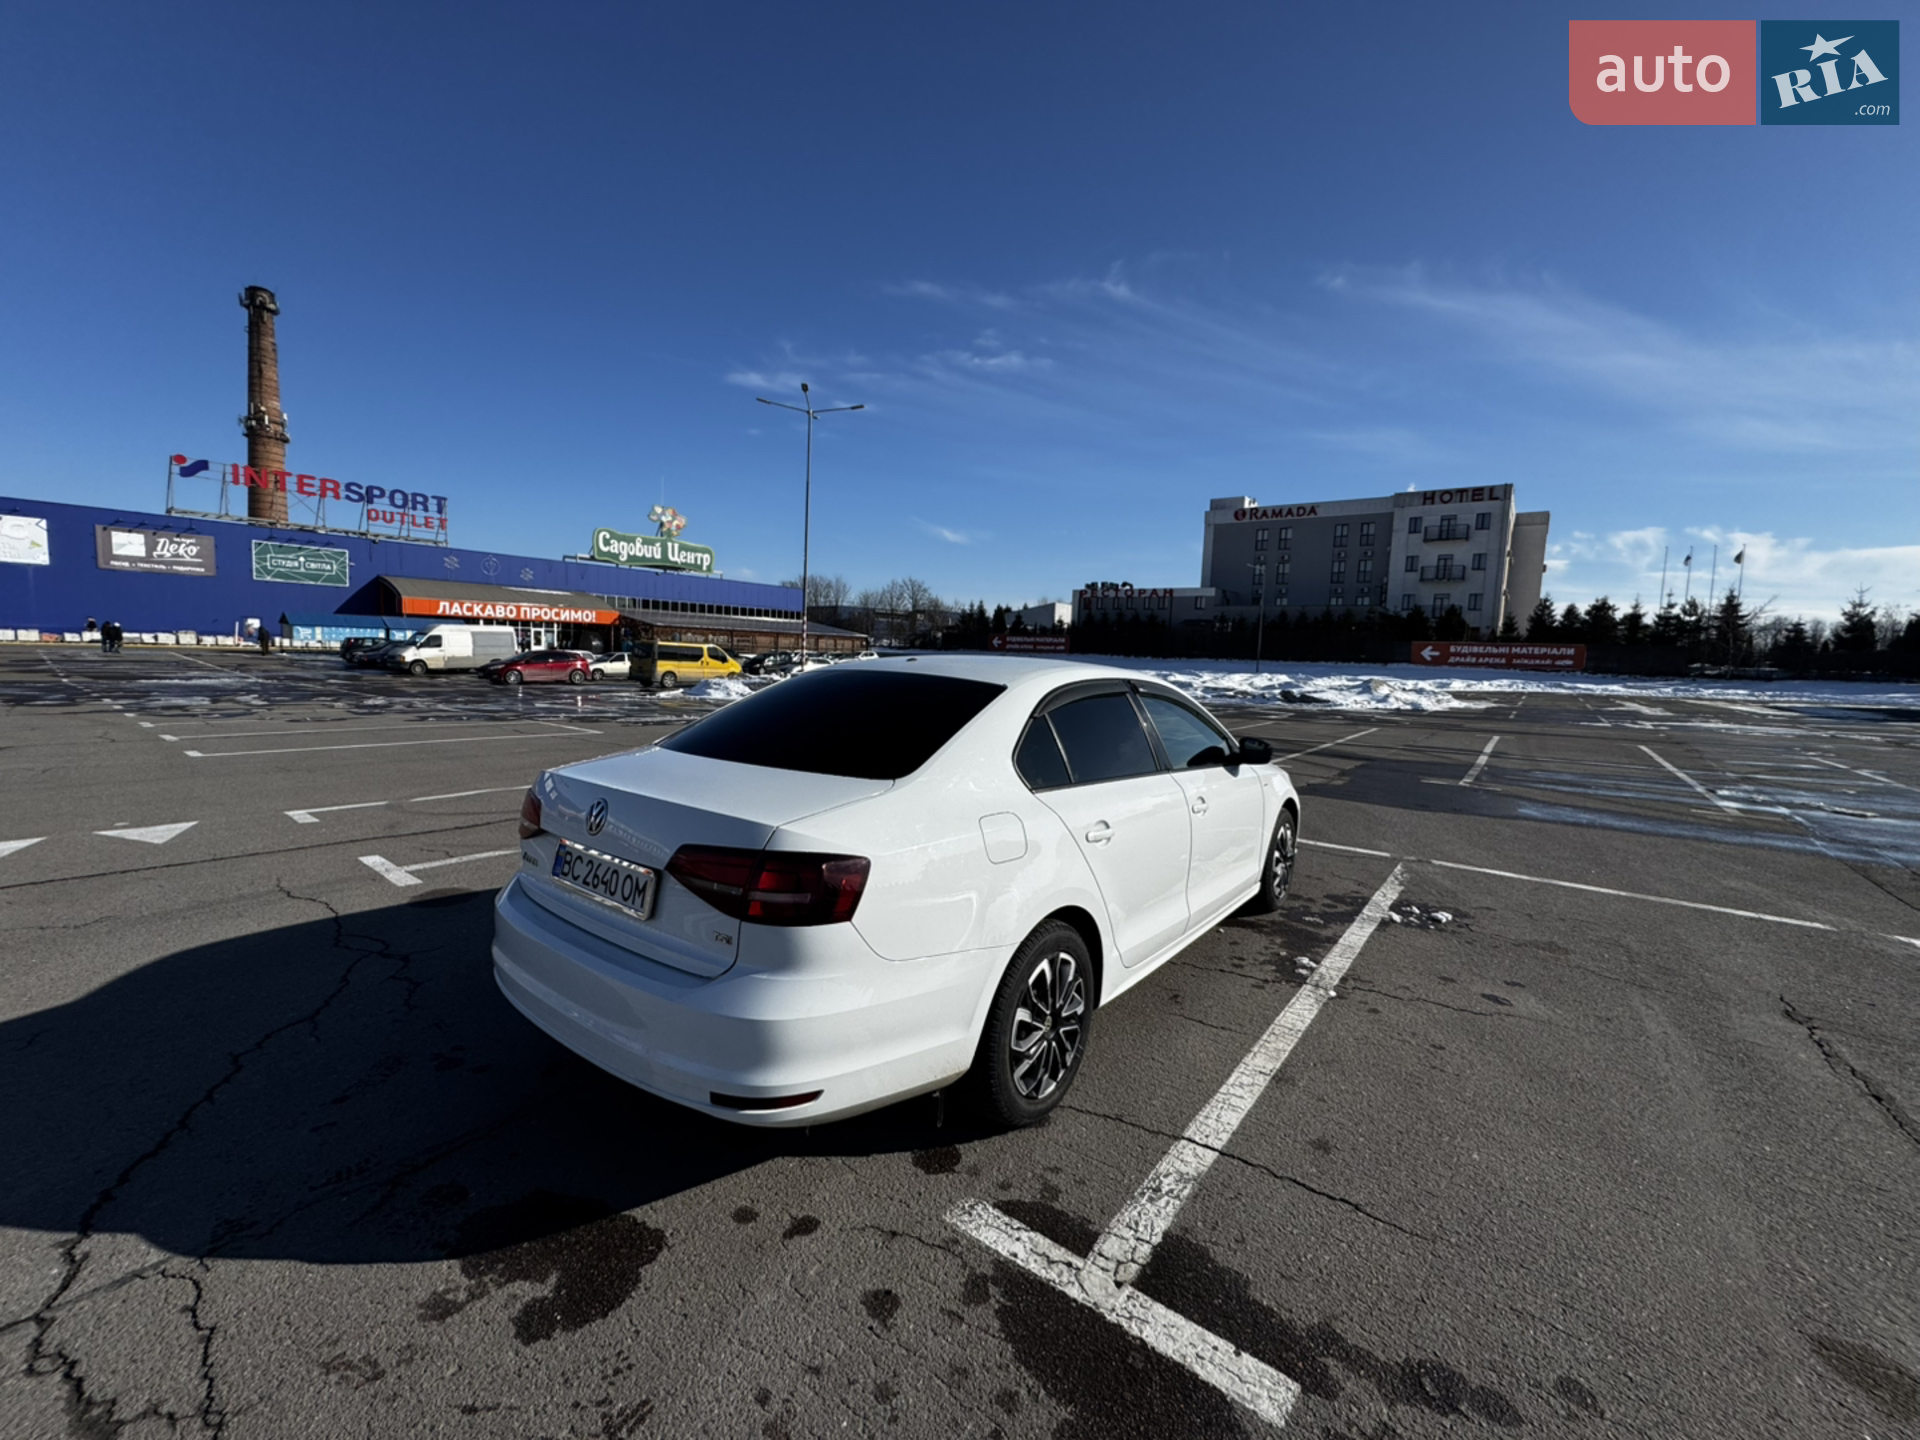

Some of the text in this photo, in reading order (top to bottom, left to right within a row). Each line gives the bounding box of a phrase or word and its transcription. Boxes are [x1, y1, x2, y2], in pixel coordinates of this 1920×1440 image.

[231, 463, 448, 515] INTERSPORT
[1422, 487, 1501, 506] HOTEL
[367, 508, 447, 531] OUTLET
[1250, 505, 1318, 521] RAMADA
[152, 537, 198, 560] Деко
[598, 531, 711, 571] Садовий Центр
[305, 561, 332, 570] СВІТЛА
[1079, 588, 1174, 599] РЕСТОРАН
[437, 601, 597, 623] ЛАСКАВО ПРОСИМО!
[1449, 645, 1575, 656] БУДІВЕЛЬНІ МАТЕРІАЛИ
[1477, 656, 1506, 665] АРЕНА
[561, 851, 584, 881] BC
[582, 859, 619, 897] 2640
[621, 873, 649, 909] OM
